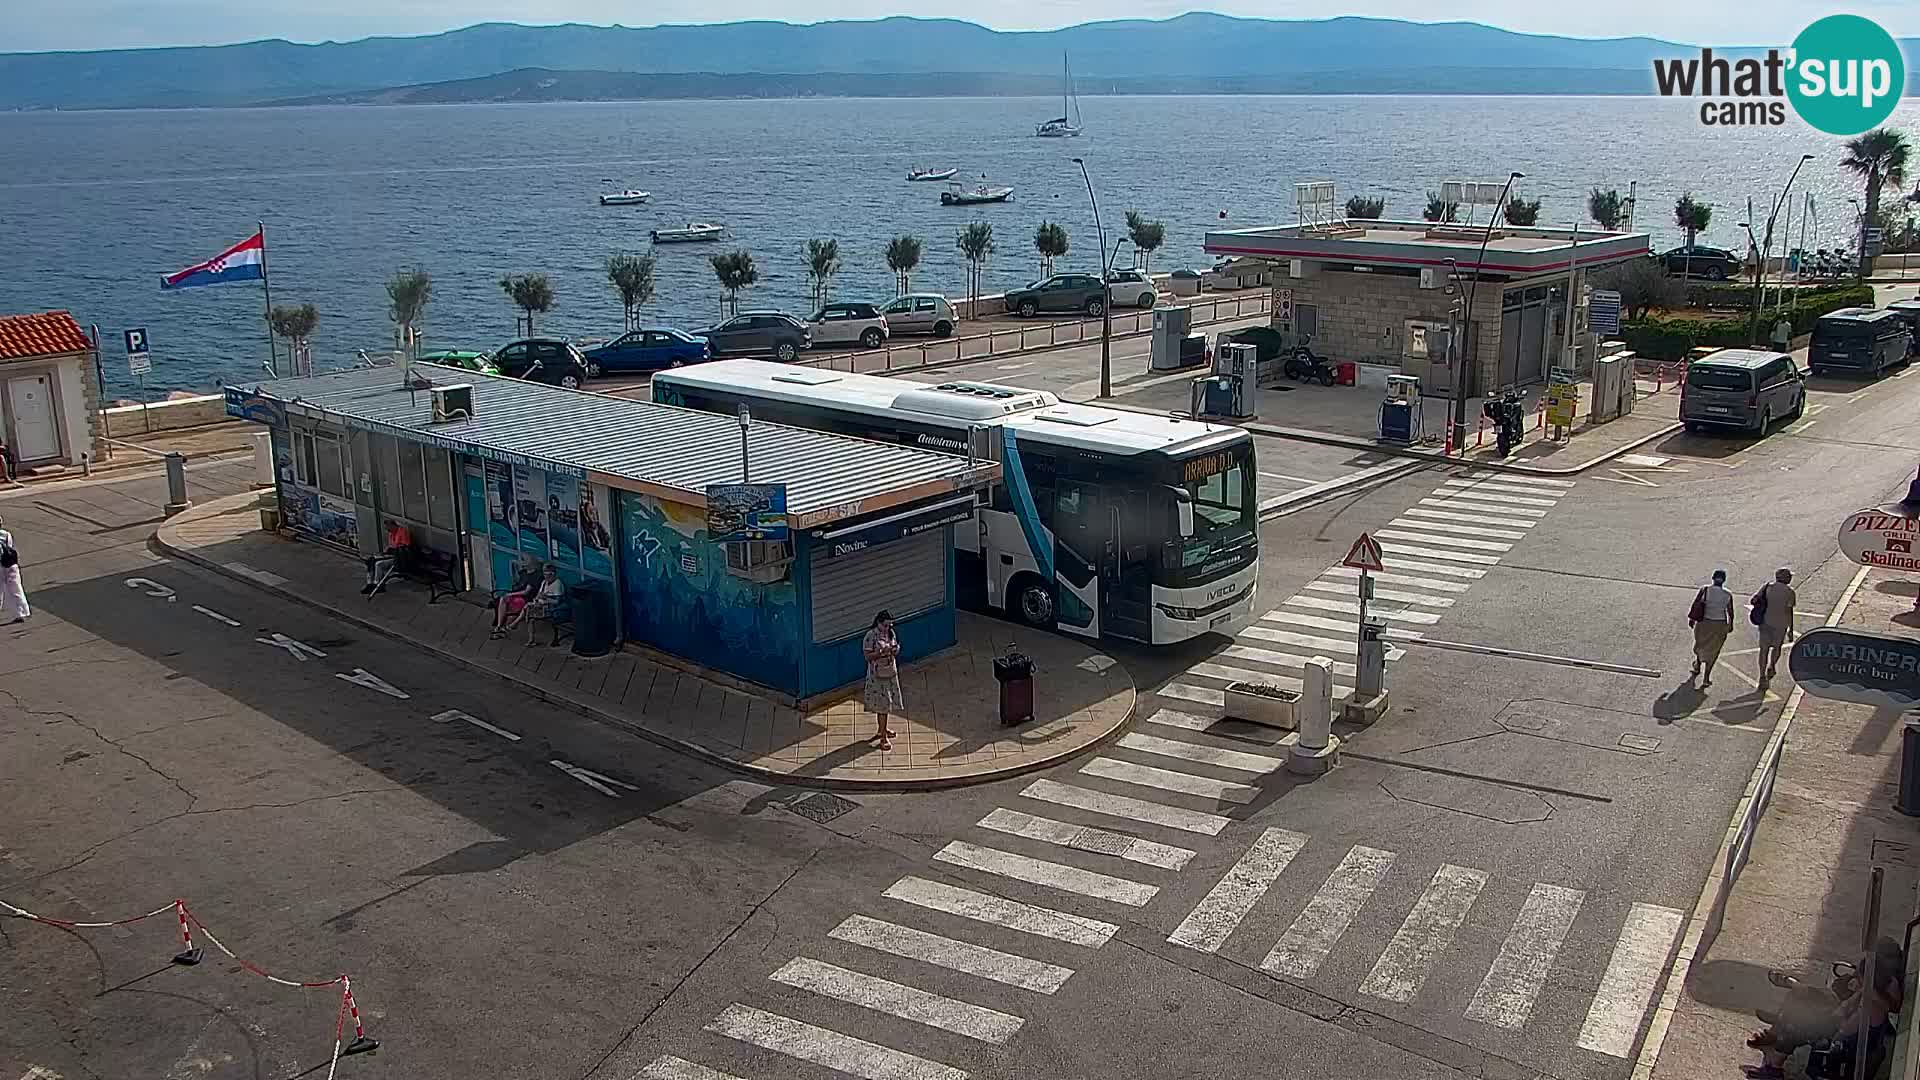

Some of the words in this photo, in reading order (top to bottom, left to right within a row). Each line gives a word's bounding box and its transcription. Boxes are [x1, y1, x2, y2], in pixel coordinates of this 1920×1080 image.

[129, 332, 142, 350] P
[918, 433, 962, 449] Autotrans
[437, 437, 467, 452] POSTAJA
[478, 447, 493, 458] BUS
[494, 451, 526, 466] STATION
[529, 458, 553, 471] TICKET
[555, 463, 582, 477] OFFICE
[1185, 455, 1217, 481] ARRIVA
[1848, 516, 1920, 534] PIZZE
[1883, 531, 1918, 541] GRILL
[1206, 583, 1236, 601] IVECO
[1801, 643, 1920, 675] MARINER
[1871, 667, 1898, 680] bar
